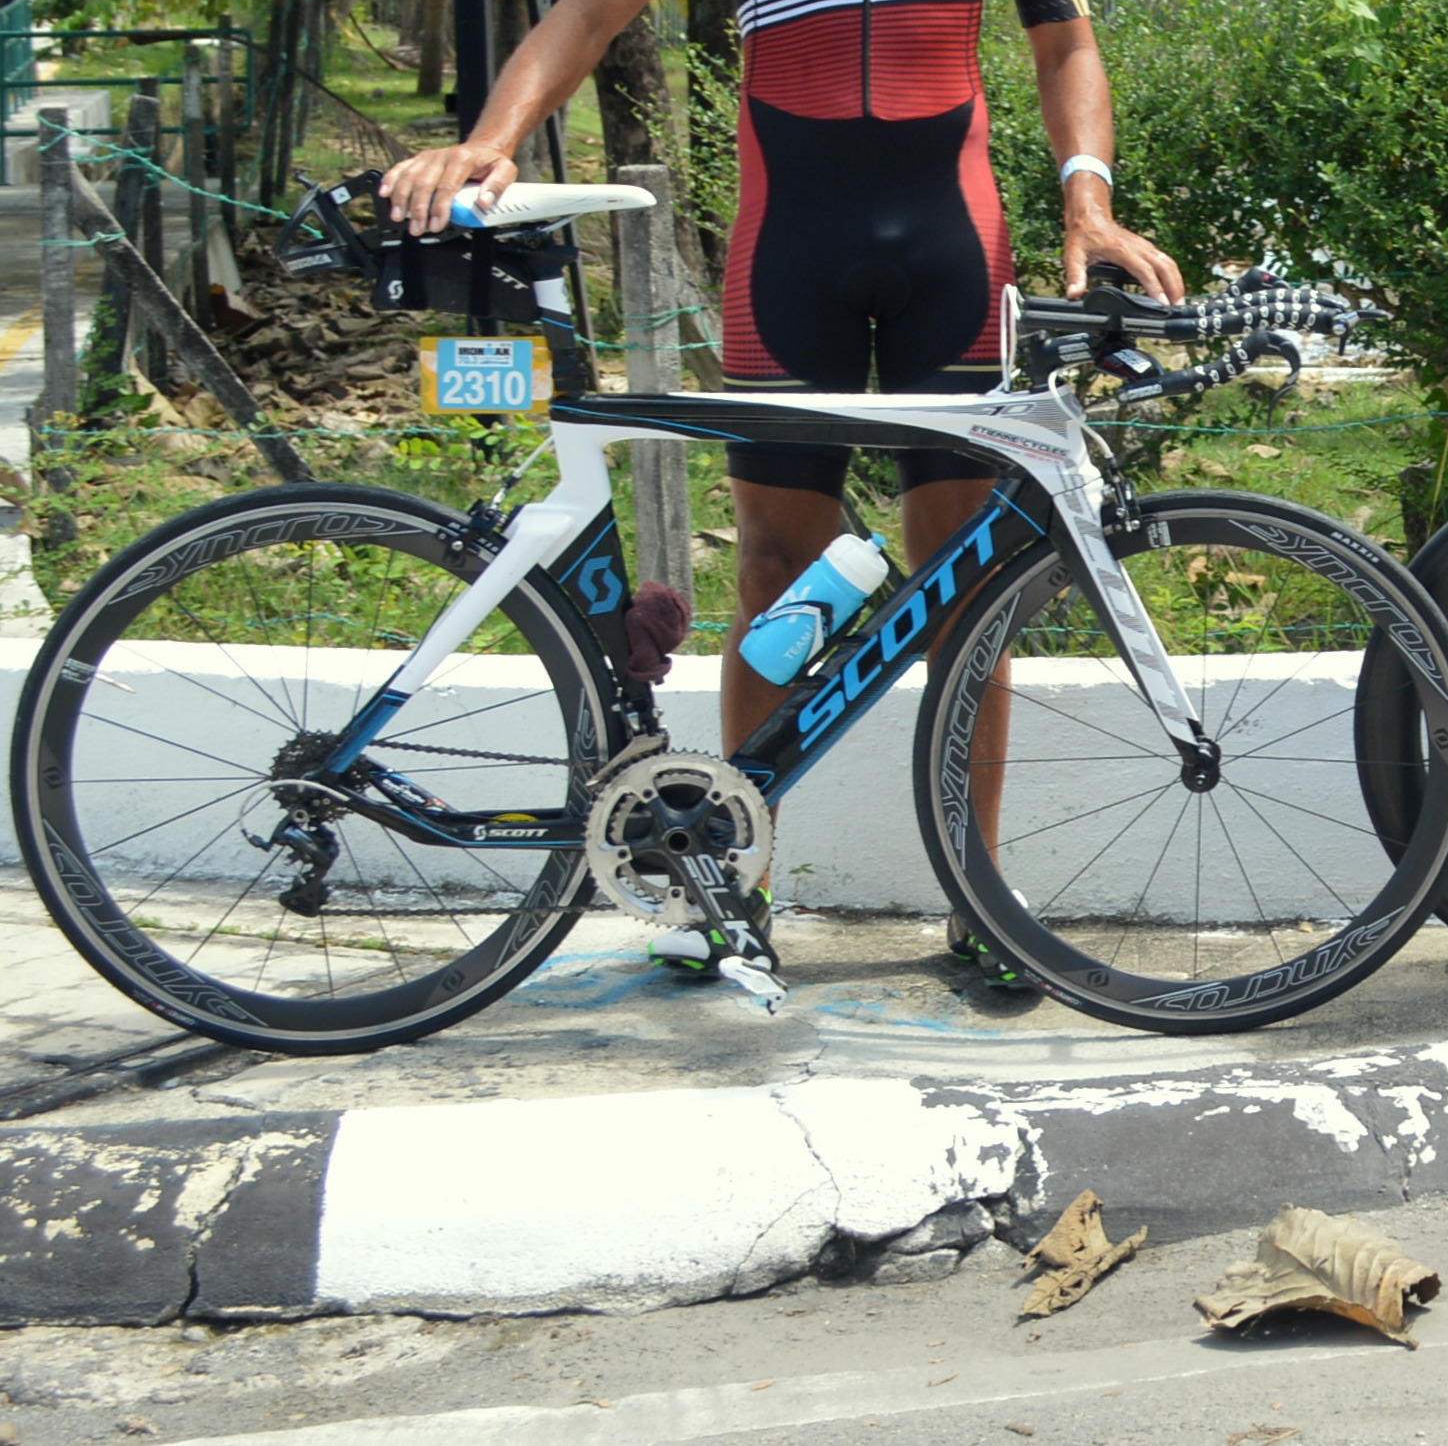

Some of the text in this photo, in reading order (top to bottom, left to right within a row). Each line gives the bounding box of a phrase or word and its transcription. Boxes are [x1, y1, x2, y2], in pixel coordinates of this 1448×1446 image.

[443, 370, 526, 405] 2310
[1330, 530, 1381, 564] MAXXIS
[784, 629, 813, 661] TEAM
[798, 507, 1002, 751] SCOTT
[488, 827, 549, 840] SCOTT
[697, 853, 764, 954] SL-K
